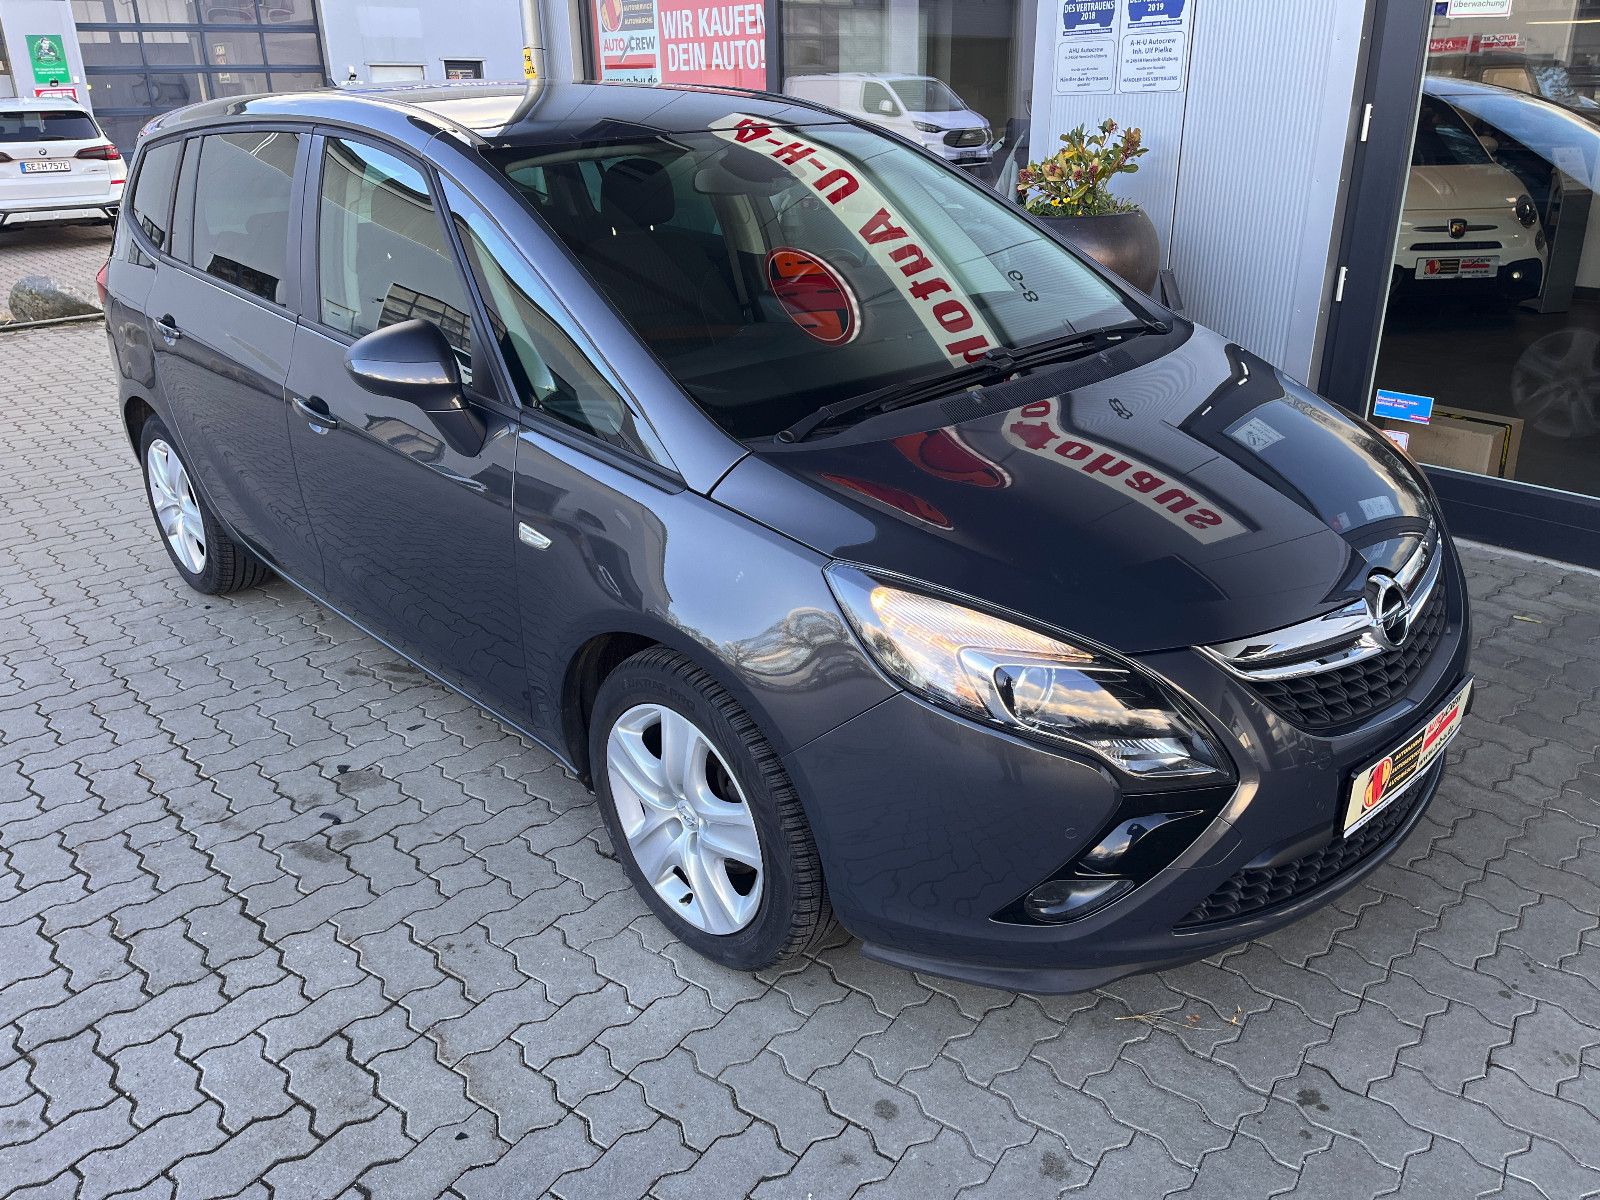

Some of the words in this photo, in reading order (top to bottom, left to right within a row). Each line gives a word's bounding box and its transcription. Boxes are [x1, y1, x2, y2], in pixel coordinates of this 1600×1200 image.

[1064, 4, 1076, 13] DES
[1076, 0, 1115, 12] VERTRAUENS
[1147, 3, 1164, 12] 2019
[661, 10, 694, 39] WIR
[698, 4, 766, 37] KAUFEN
[1080, 12, 1096, 21] 2018
[667, 41, 706, 72] DEIN
[711, 39, 766, 70] AUTO!
